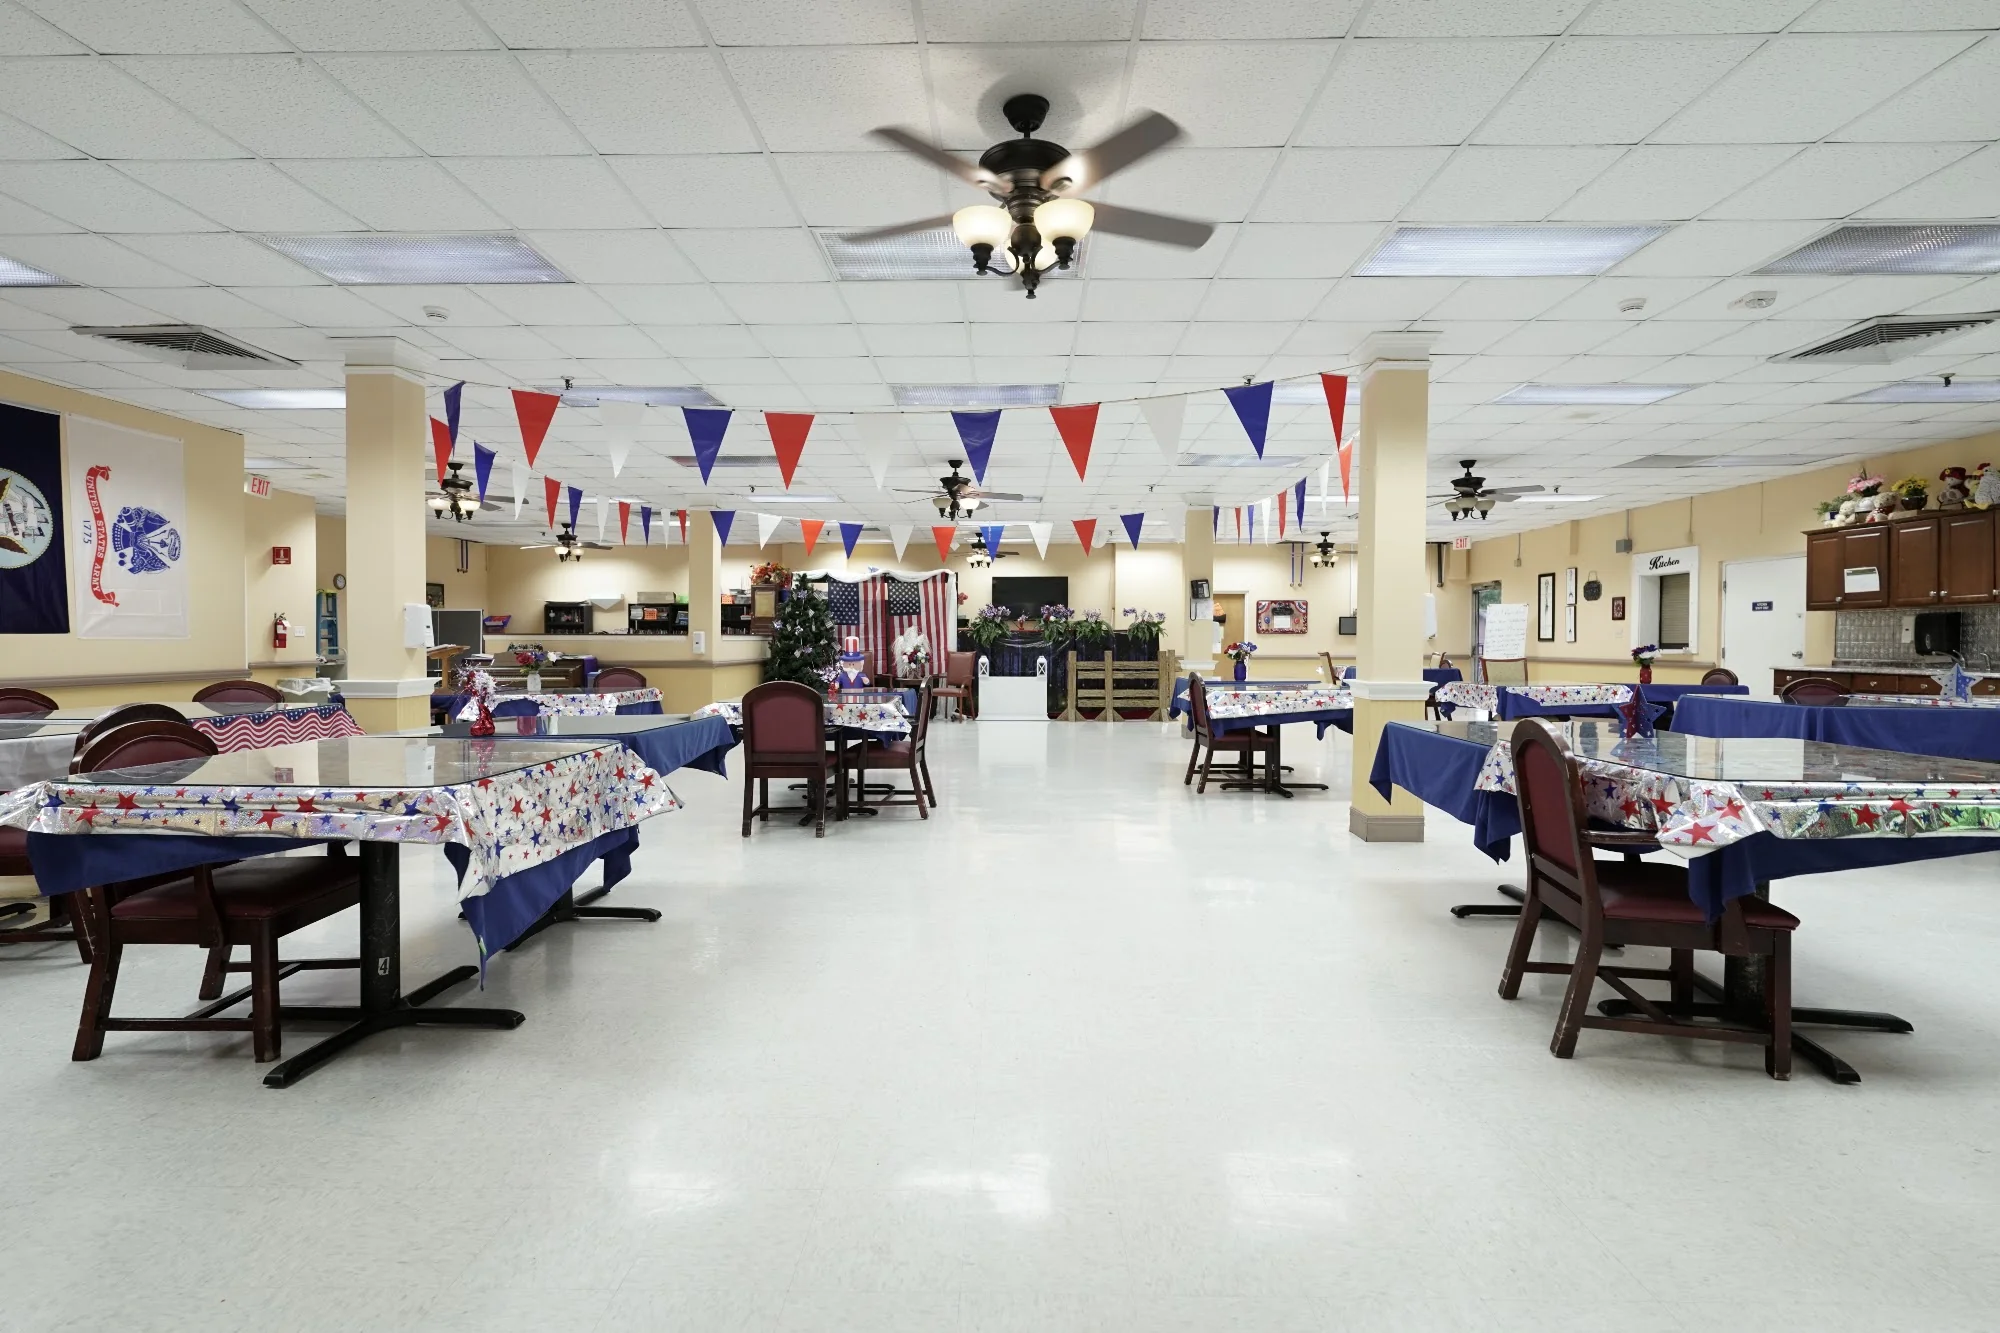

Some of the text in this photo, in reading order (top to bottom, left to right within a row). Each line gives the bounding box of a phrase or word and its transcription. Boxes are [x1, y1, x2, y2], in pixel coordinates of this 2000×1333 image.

[251, 477, 271, 497] EXIT
[83, 520, 92, 544] 1775
[87, 475, 107, 592] UNITED STATES ARMY
[1648, 555, 1680, 571] Kitchen
[379, 958, 388, 974] 4
